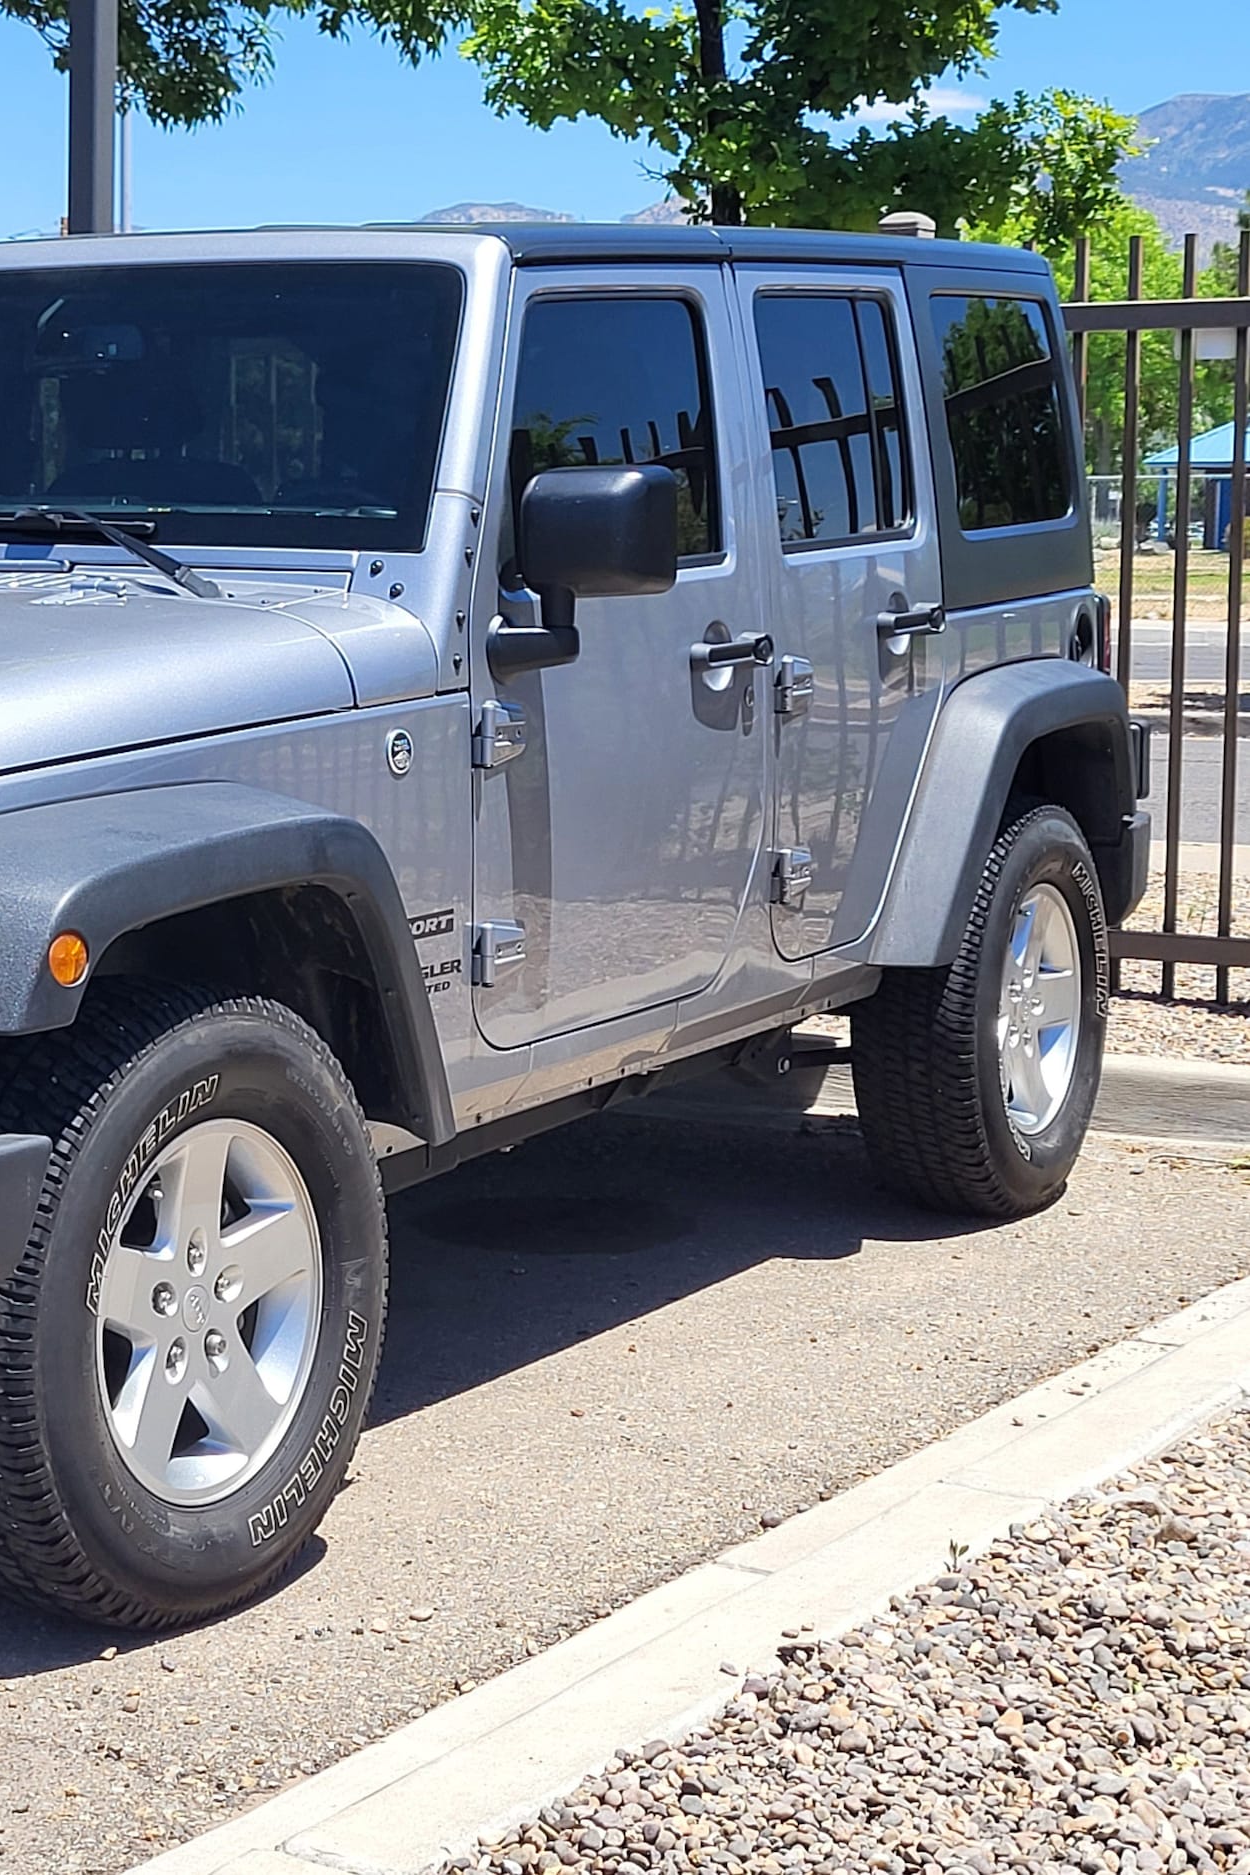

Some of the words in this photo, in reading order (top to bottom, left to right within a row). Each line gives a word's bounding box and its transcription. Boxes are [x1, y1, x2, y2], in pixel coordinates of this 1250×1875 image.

[409, 914, 454, 936] ORT
[1072, 861, 1108, 1018] MICHELIN
[86, 1073, 220, 1317] MICHELIN
[249, 1311, 369, 1547] MICHELIN
